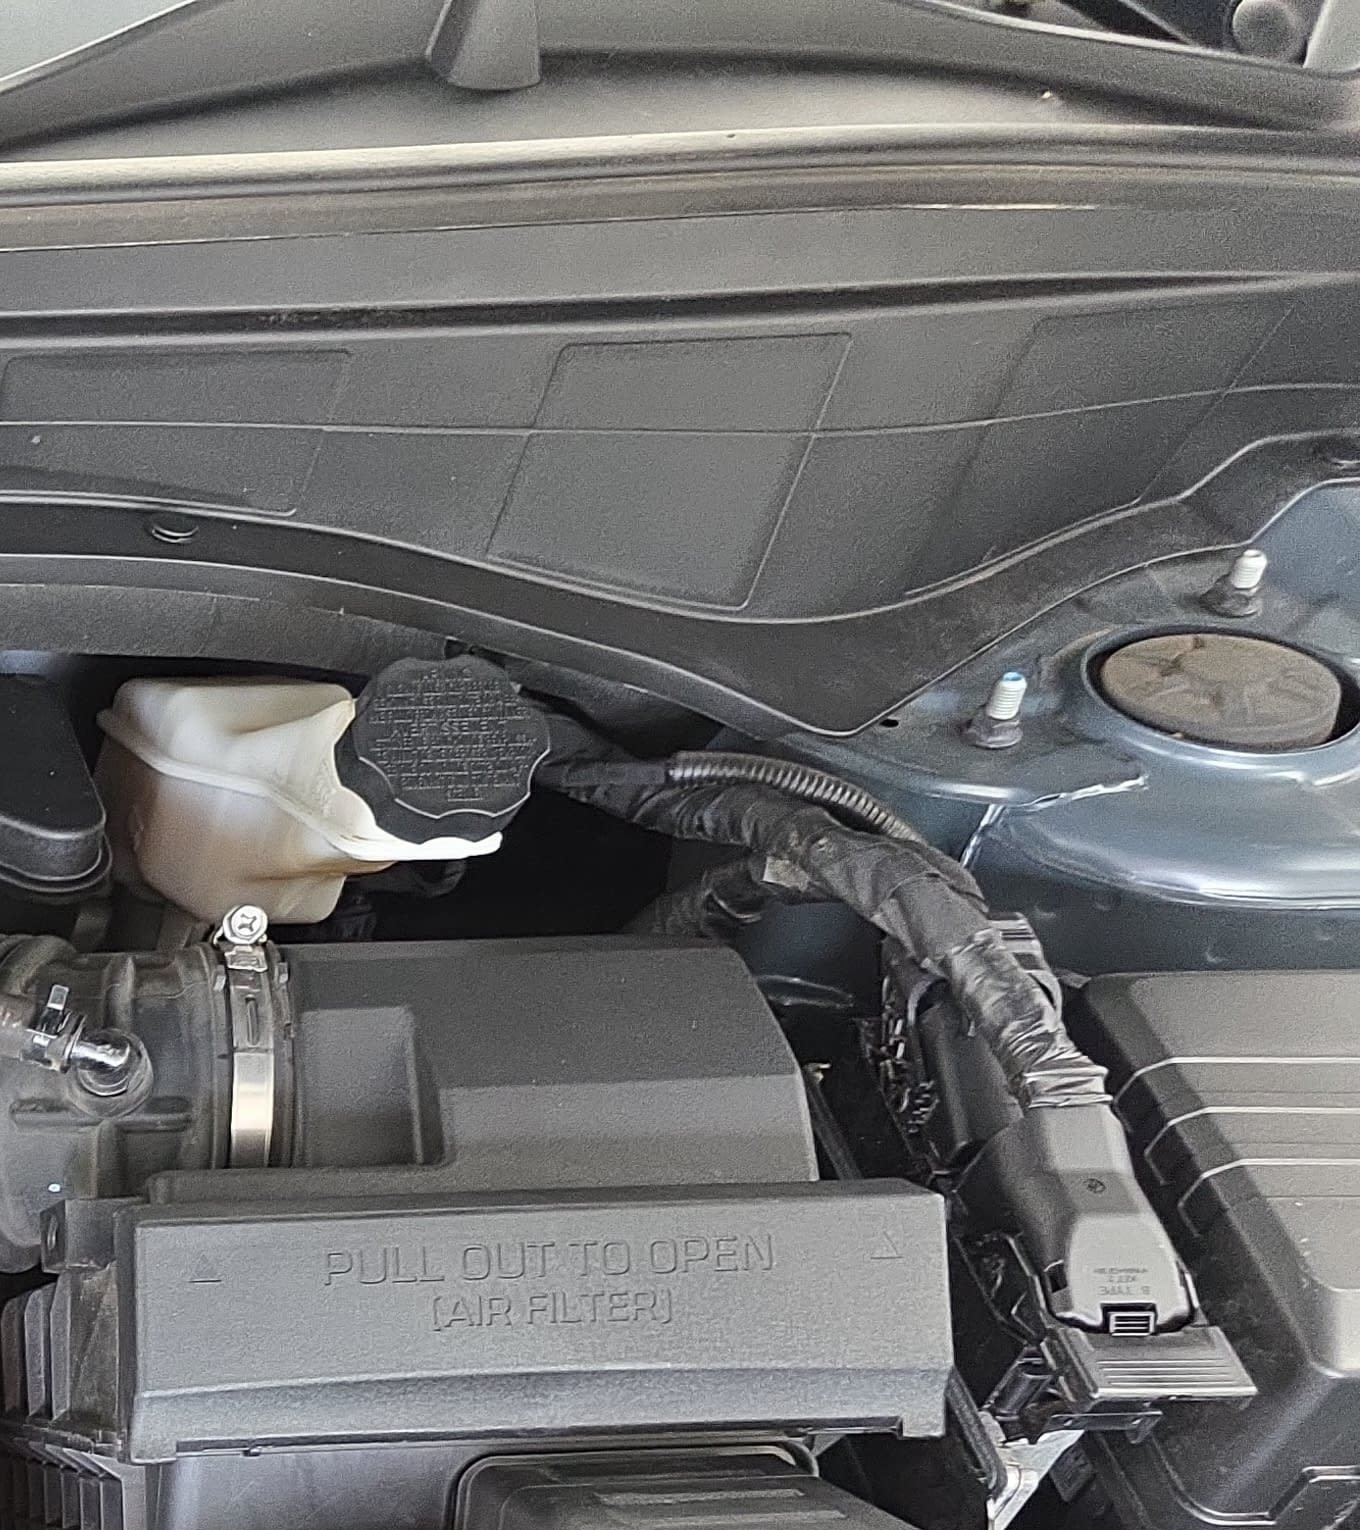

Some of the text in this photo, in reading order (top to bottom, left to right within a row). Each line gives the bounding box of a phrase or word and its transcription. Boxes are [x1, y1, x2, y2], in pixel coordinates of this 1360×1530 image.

[323, 1234, 775, 1286] PULL OUT TO OPEN
